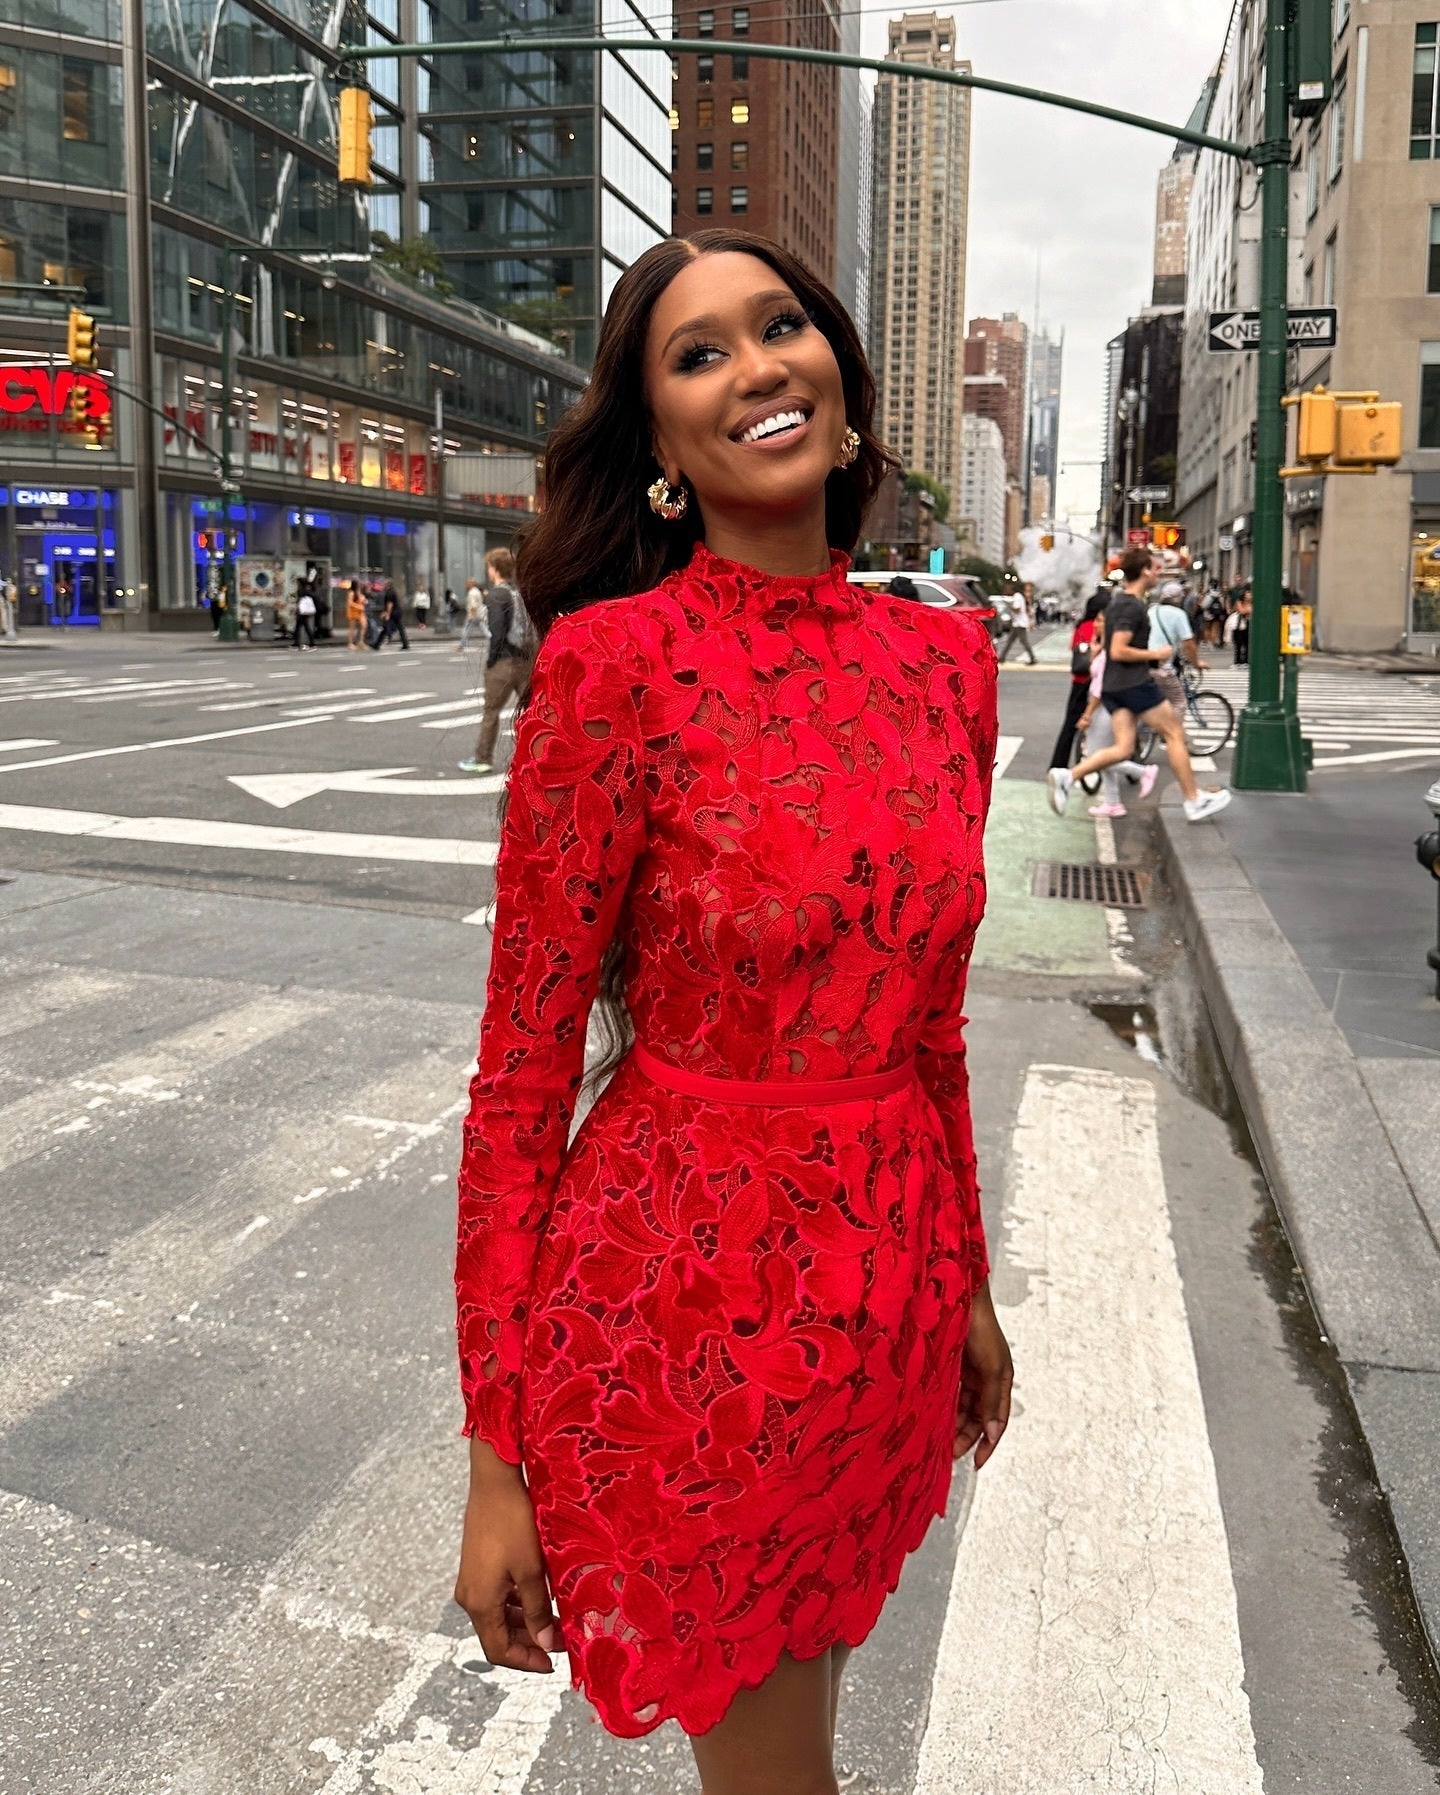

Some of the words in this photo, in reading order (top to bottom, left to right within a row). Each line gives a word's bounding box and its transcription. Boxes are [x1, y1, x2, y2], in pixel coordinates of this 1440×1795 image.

[1221, 322, 1261, 340] ONE
[1285, 319, 1325, 337] WAY
[0, 366, 111, 418] CVS
[16, 489, 70, 506] CHASE
